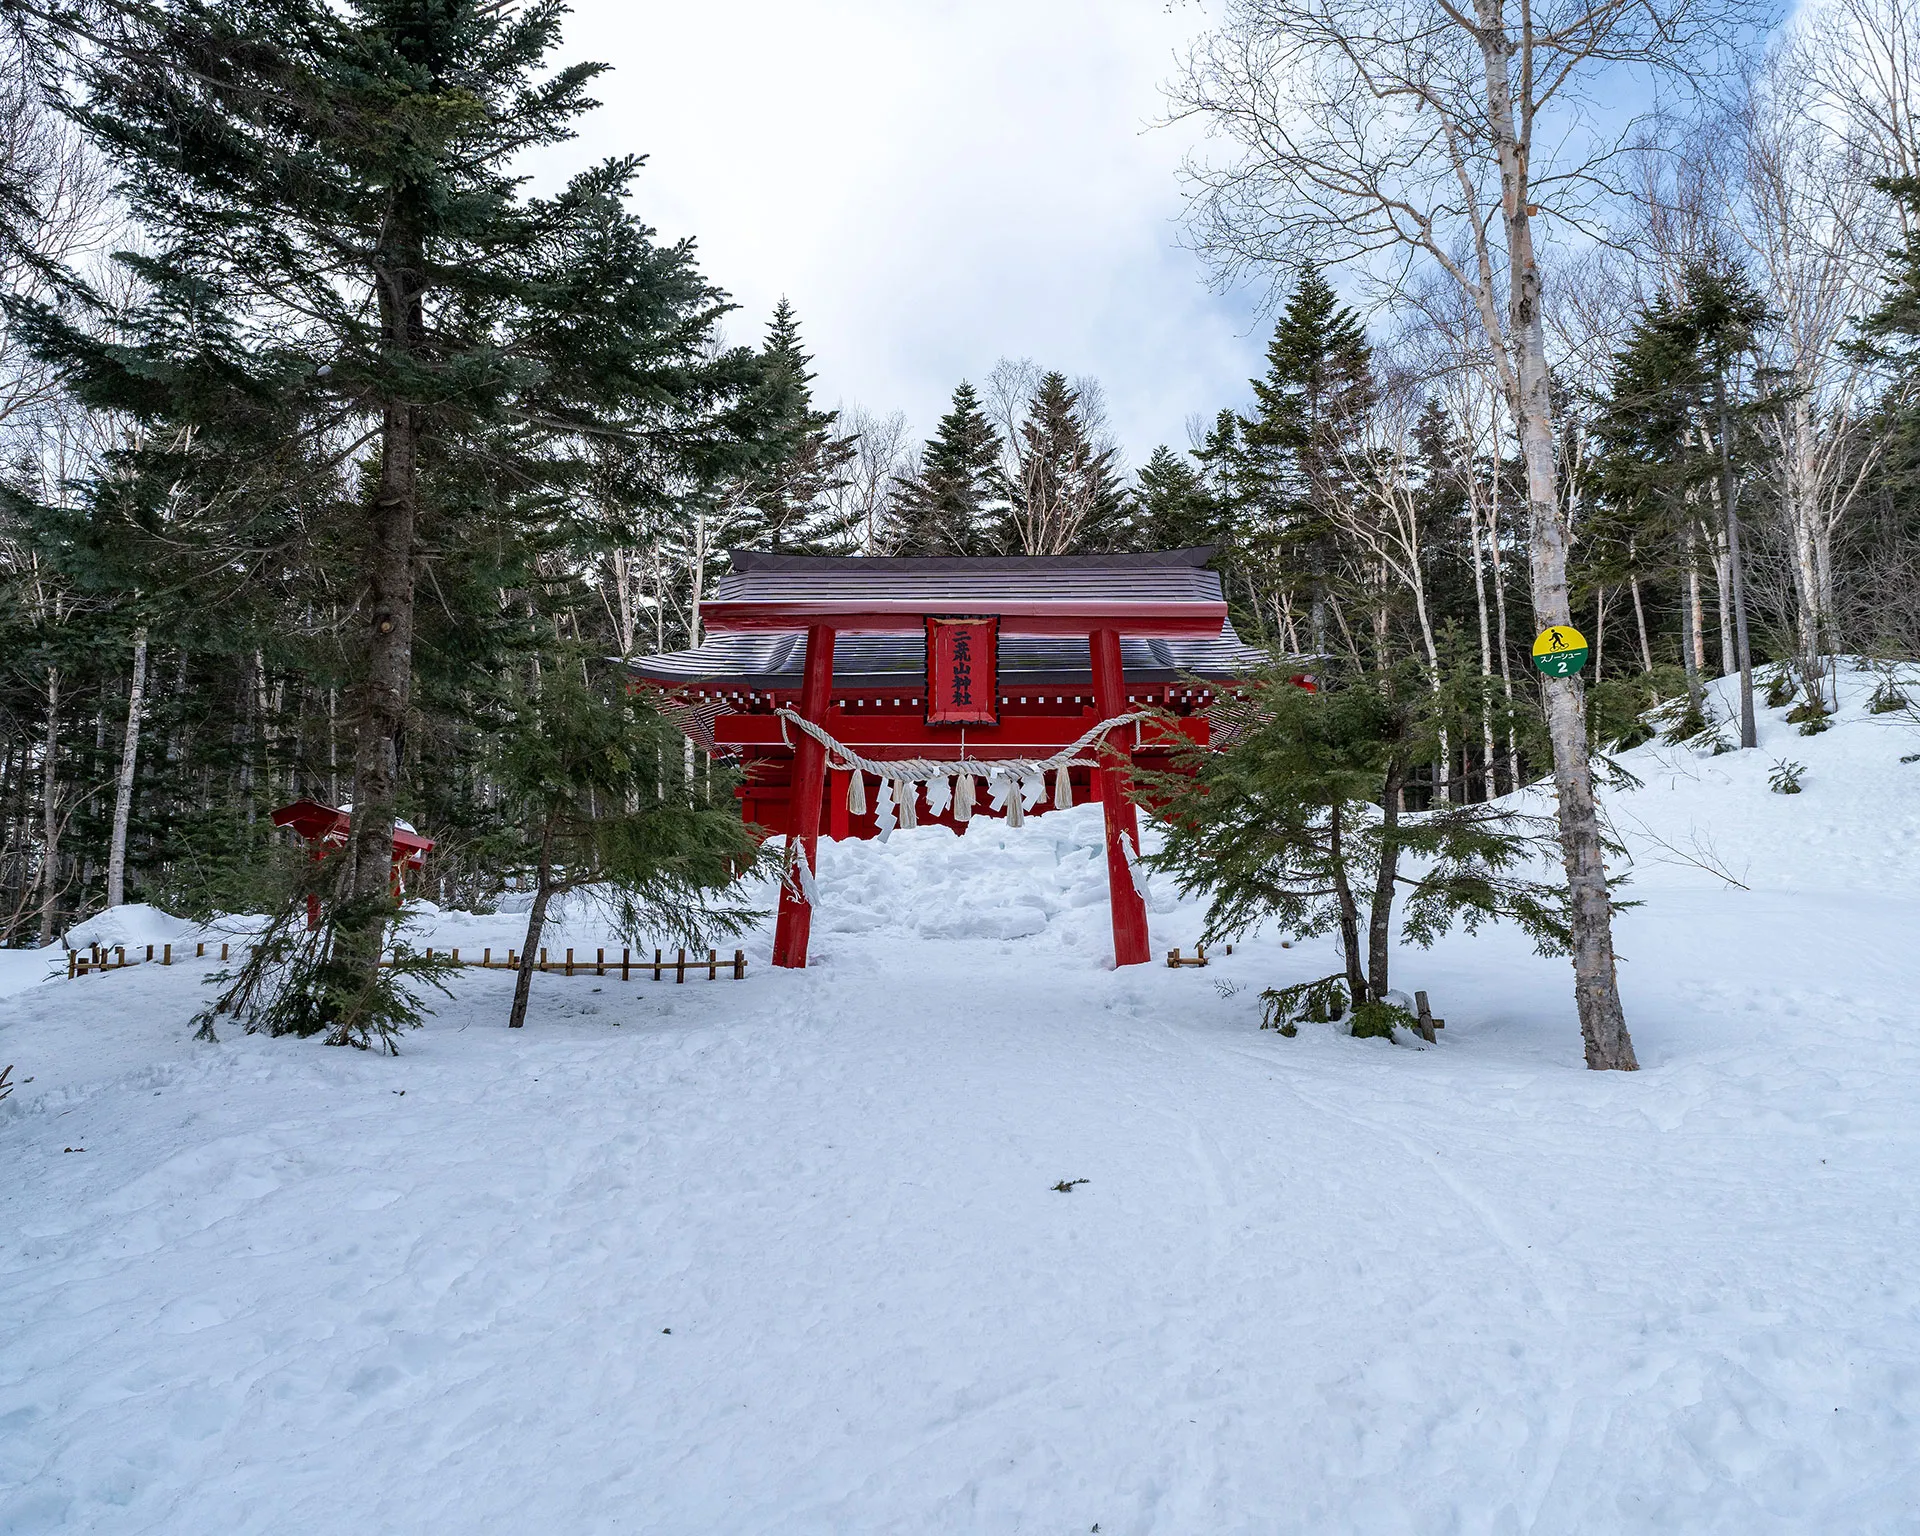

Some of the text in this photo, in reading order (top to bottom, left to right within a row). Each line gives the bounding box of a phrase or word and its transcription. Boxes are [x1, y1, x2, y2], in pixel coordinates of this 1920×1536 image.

[1540, 652, 1582, 664] スノーシュー
[951, 631, 972, 707] 二荒山神社
[1557, 661, 1568, 673] 2
